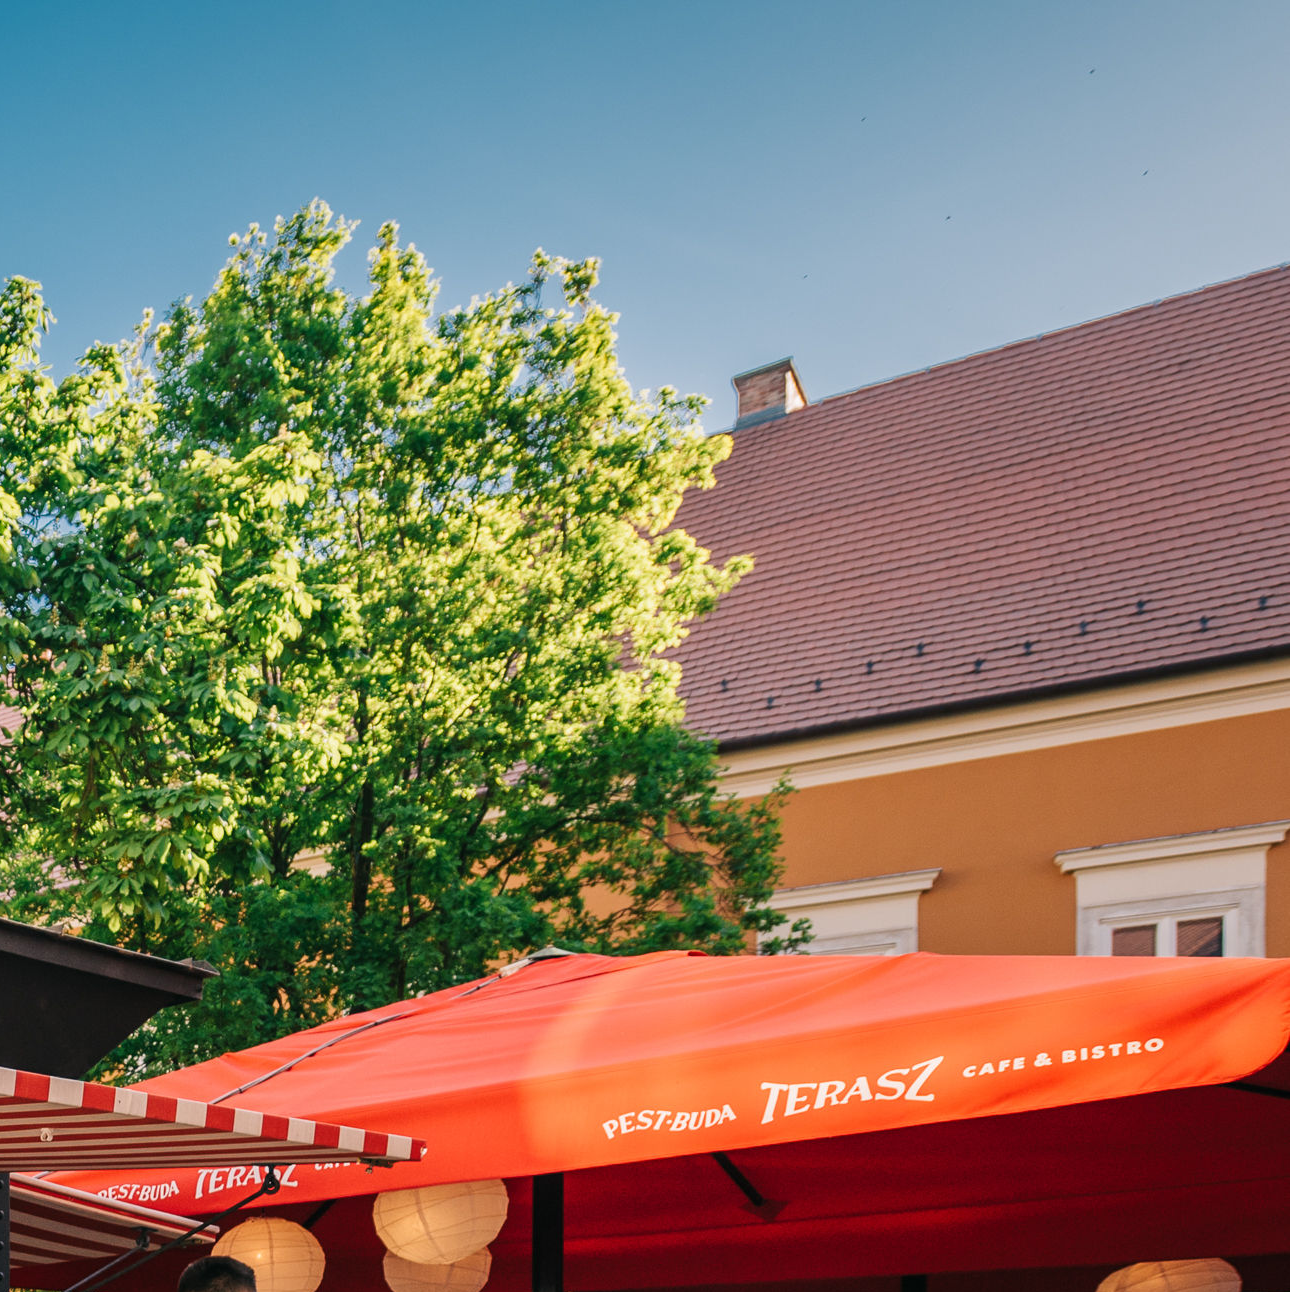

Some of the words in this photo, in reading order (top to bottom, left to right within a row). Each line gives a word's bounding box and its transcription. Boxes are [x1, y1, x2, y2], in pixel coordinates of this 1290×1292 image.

[760, 1055, 945, 1125] TERASZ
[962, 1056, 1026, 1078] CAFE
[1033, 1052, 1053, 1068] &
[1061, 1037, 1165, 1064] BISTRO
